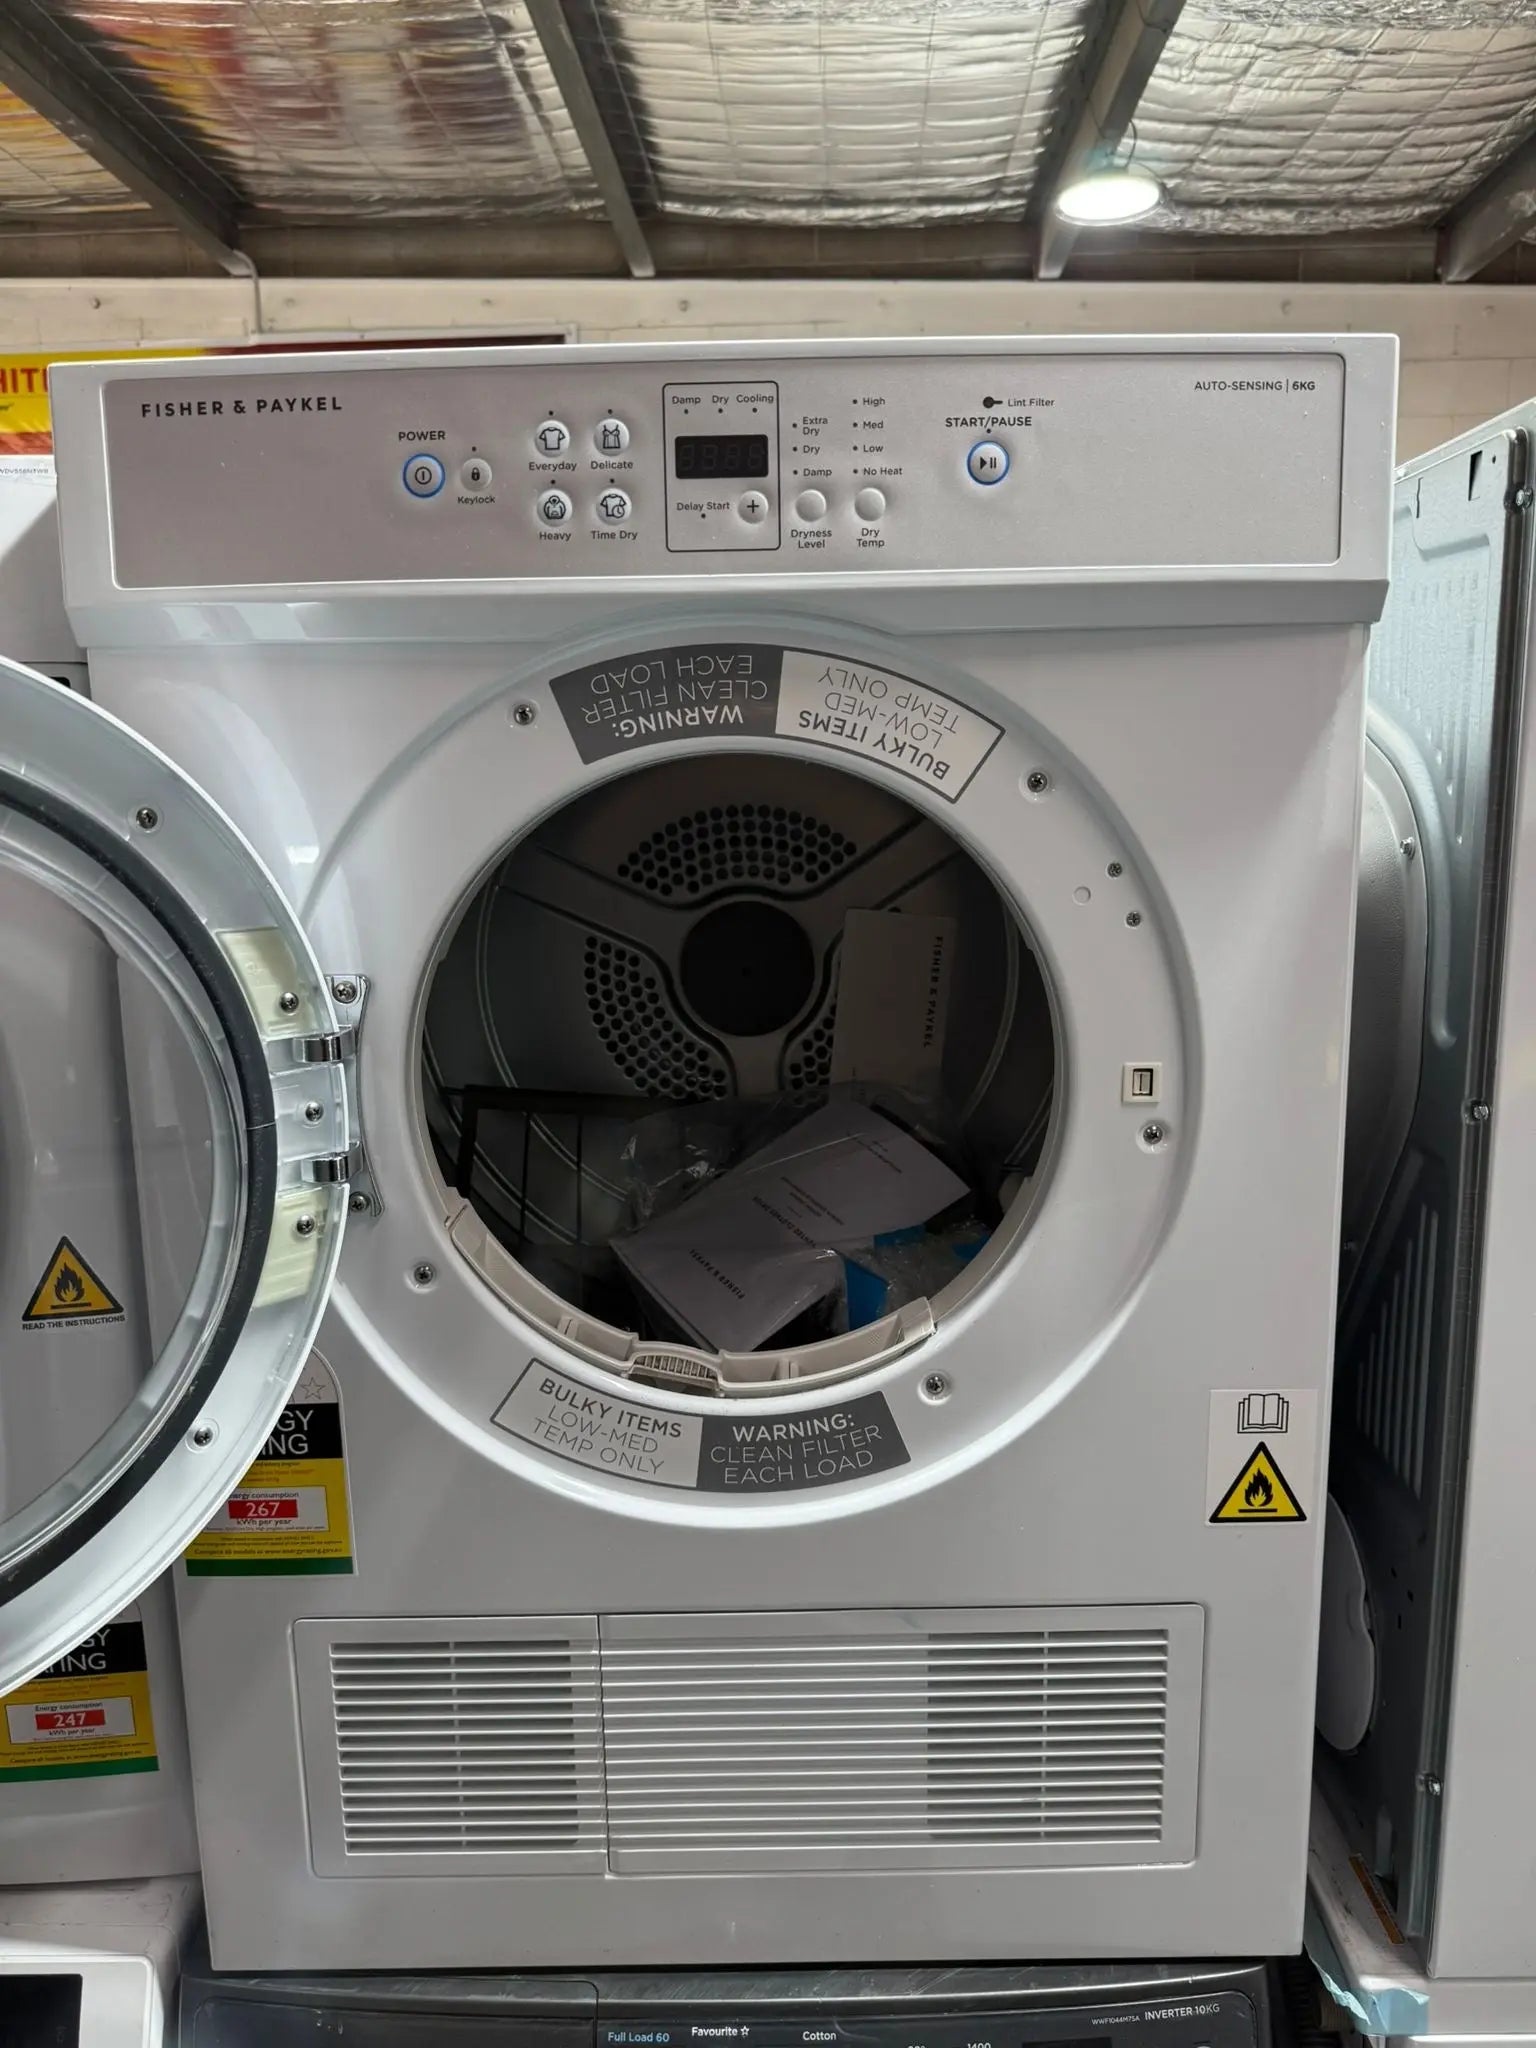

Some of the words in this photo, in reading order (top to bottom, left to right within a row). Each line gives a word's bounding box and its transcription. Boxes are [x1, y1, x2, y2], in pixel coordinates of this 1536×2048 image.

[1194, 380, 1283, 392] AUTO-SENSING
[1292, 380, 1316, 392] 6KG
[672, 395, 701, 406] Damp
[712, 395, 729, 404] Dry
[736, 394, 774, 405] Cooling
[862, 397, 886, 406] High
[1007, 398, 1026, 407] Lint
[1029, 398, 1055, 407] Filter
[141, 401, 223, 418] FISHER
[234, 400, 247, 414] &
[257, 396, 343, 413] PAYKEL
[802, 416, 828, 425] Extra
[863, 420, 884, 430] Med
[945, 416, 1032, 429] START/PAUSE
[398, 430, 446, 442] POWER
[803, 426, 820, 436] Dry
[803, 445, 820, 455] Dry
[863, 444, 884, 453] Low
[529, 461, 577, 472] Everyday
[590, 460, 634, 470] Delicate
[863, 467, 878, 476] No
[880, 466, 903, 476] Heat
[803, 467, 832, 477] Damp
[457, 495, 495, 505] Keylock
[676, 502, 704, 512] Delay
[707, 501, 730, 511] Start
[539, 531, 572, 542] Heavy
[590, 531, 616, 540] Time
[619, 531, 638, 541] Dry
[790, 529, 832, 539] Dryness
[861, 528, 880, 538] Dry
[798, 539, 826, 549] Level
[856, 538, 885, 549] Temp
[678, 655, 752, 674] EACH
[591, 661, 666, 695] LOAD
[818, 665, 889, 698] ONLY
[680, 678, 768, 700] CLEAN
[583, 686, 668, 724] FILTER
[893, 693, 959, 734] TEMP
[614, 704, 744, 738] WARNING:
[799, 710, 870, 743] ITEMS
[825, 692, 944, 749] LOW-MED
[874, 736, 950, 780] BULKY
[22, 1322, 45, 1331] READ
[46, 1320, 63, 1329] THE
[65, 1315, 125, 1328] INSTRUCTIONS
[538, 1377, 610, 1419] BULKY
[617, 1410, 682, 1439] ITEMS
[548, 1404, 658, 1454] LOW-MED
[732, 1412, 855, 1443] WARNING:
[533, 1417, 594, 1454] TEMP
[600, 1447, 665, 1475] ONLY
[710, 1446, 793, 1464] CLEAN
[803, 1425, 882, 1458] FILTER
[724, 1467, 793, 1485] EACH
[805, 1449, 873, 1479] LOAD
[228, 1492, 251, 1500] nergy
[252, 1491, 300, 1499] consumption
[245, 1502, 281, 1518] 267
[275, 1519, 292, 1527] year
[54, 1712, 87, 1727] 247
[1144, 2007, 1193, 2021] INVERTER
[1195, 2003, 1221, 2015] 10KG
[608, 2032, 626, 2042] Full
[629, 2032, 654, 2042] Load
[656, 2033, 670, 2043] 60
[691, 2026, 738, 2037] Favourite
[802, 2031, 837, 2041] Cotton
